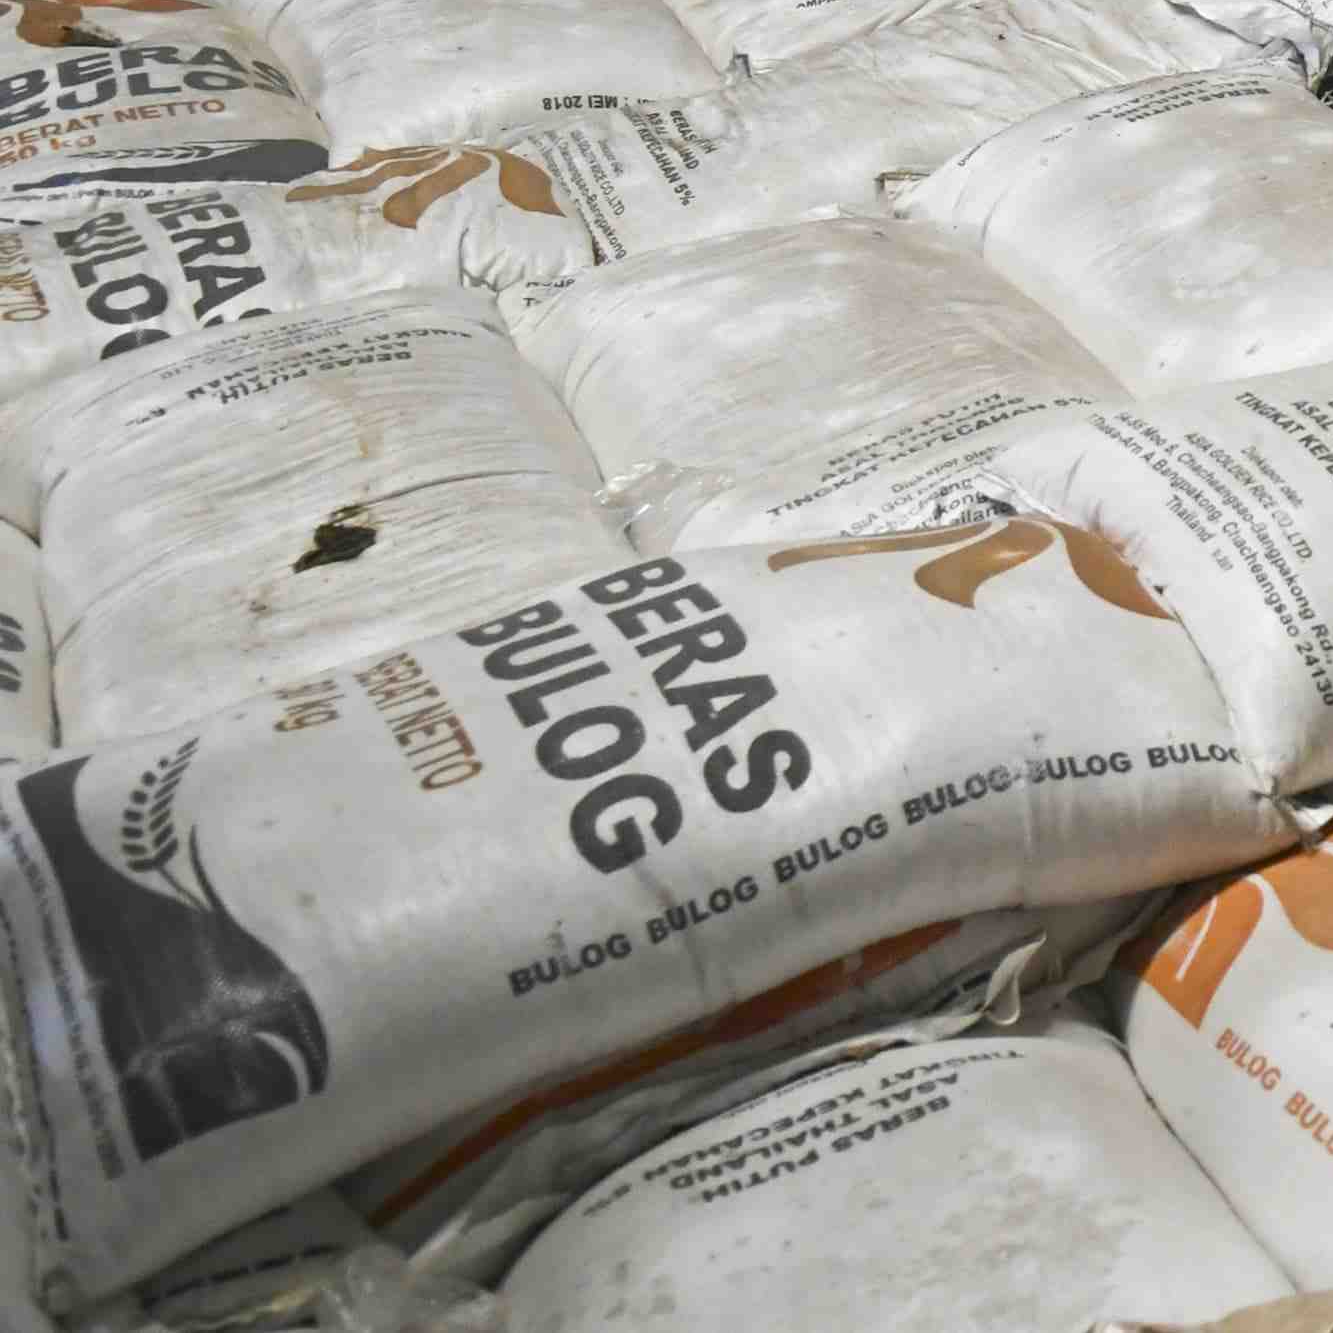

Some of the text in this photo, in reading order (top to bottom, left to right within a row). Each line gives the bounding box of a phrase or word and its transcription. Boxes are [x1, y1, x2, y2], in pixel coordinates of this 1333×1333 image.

[0, 97, 226, 153] BERAT NETTO
[542, 94, 619, 111] MEI 2018
[145, 190, 272, 329] BERA
[1233, 390, 1302, 436] TINGKAT
[1292, 399, 1333, 434] ASAL
[766, 463, 880, 518] TINGKAT
[1163, 494, 1212, 546] Thailand
[1221, 519, 1300, 640] Chacheangsao
[581, 556, 812, 815] BERAS
[385, 699, 484, 791] NETTO
[456, 600, 684, 874] BULOG
[507, 930, 633, 998] BULOG
[644, 876, 761, 946] BULOG
[772, 811, 889, 886] BULOG
[903, 766, 1012, 826] BULOG
[1024, 746, 1132, 787] BULOG
[877, 1048, 1026, 1092] TINGKAT
[1214, 1026, 1283, 1093] BULOG
[642, 1085, 866, 1183] KEPECAHAN
[669, 1072, 960, 1192] ASAL THAILAND
[699, 1094, 952, 1203] BERAS PUTIH
